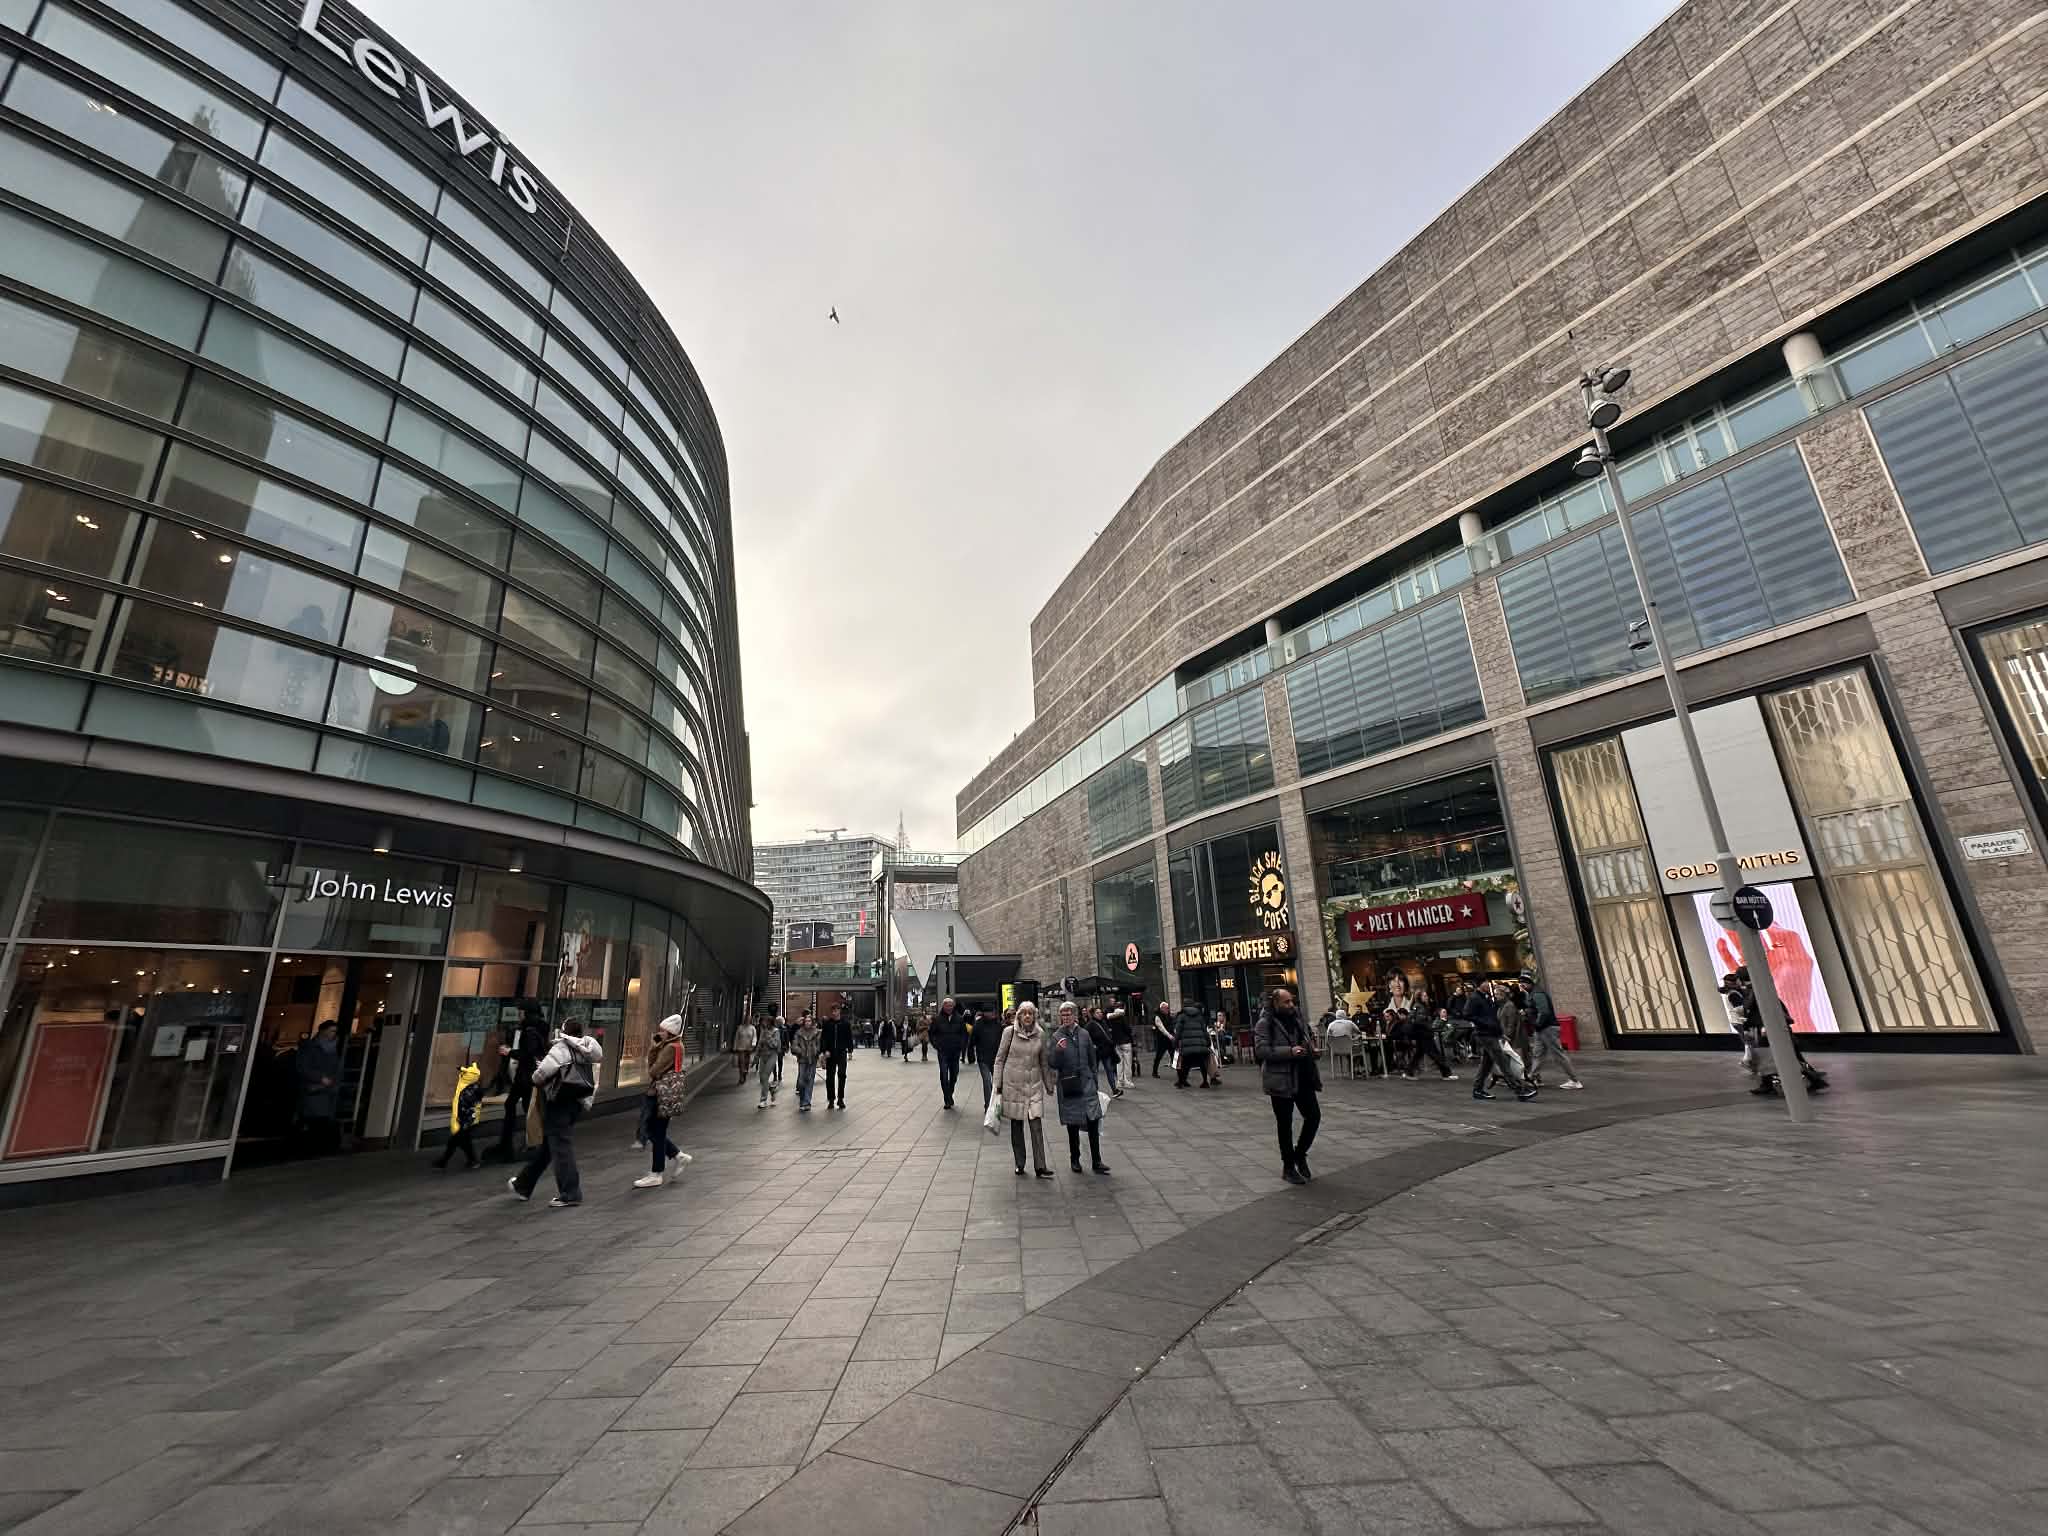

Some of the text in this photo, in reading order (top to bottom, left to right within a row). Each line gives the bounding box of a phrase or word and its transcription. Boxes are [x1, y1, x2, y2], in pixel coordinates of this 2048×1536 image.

[299, 0, 539, 213] Lewis
[1970, 838, 2017, 850] PARADISE
[1981, 846, 2014, 854] PLACE
[1264, 851, 1283, 873] SHE
[1665, 851, 1799, 880] GOLDMITHS
[307, 870, 453, 908] John Lewis
[1735, 896, 1748, 904] BAR
[1264, 900, 1289, 930] COFF
[1368, 904, 1455, 933] PRET A MANGER
[1180, 946, 1202, 967] BLACK
[1203, 943, 1230, 964] SHEEP
[1233, 938, 1272, 961] COFFEE
